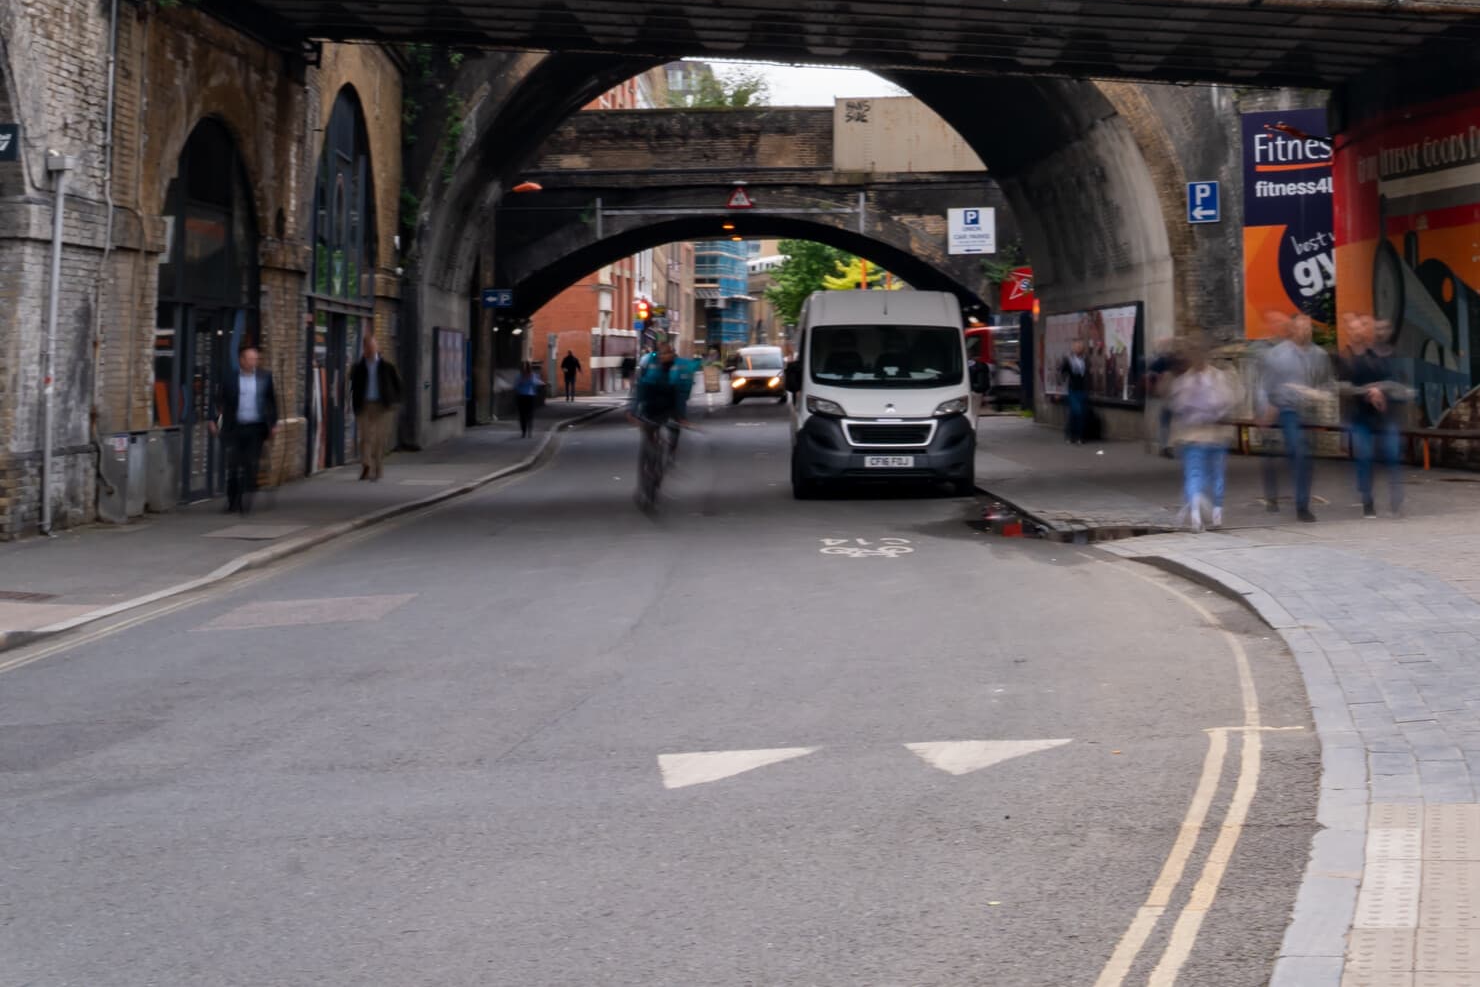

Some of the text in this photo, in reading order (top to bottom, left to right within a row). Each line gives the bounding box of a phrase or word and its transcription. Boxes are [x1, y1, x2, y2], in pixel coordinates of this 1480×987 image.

[1195, 184, 1211, 206] P
[966, 211, 977, 224] P
[1290, 231, 1328, 255] best
